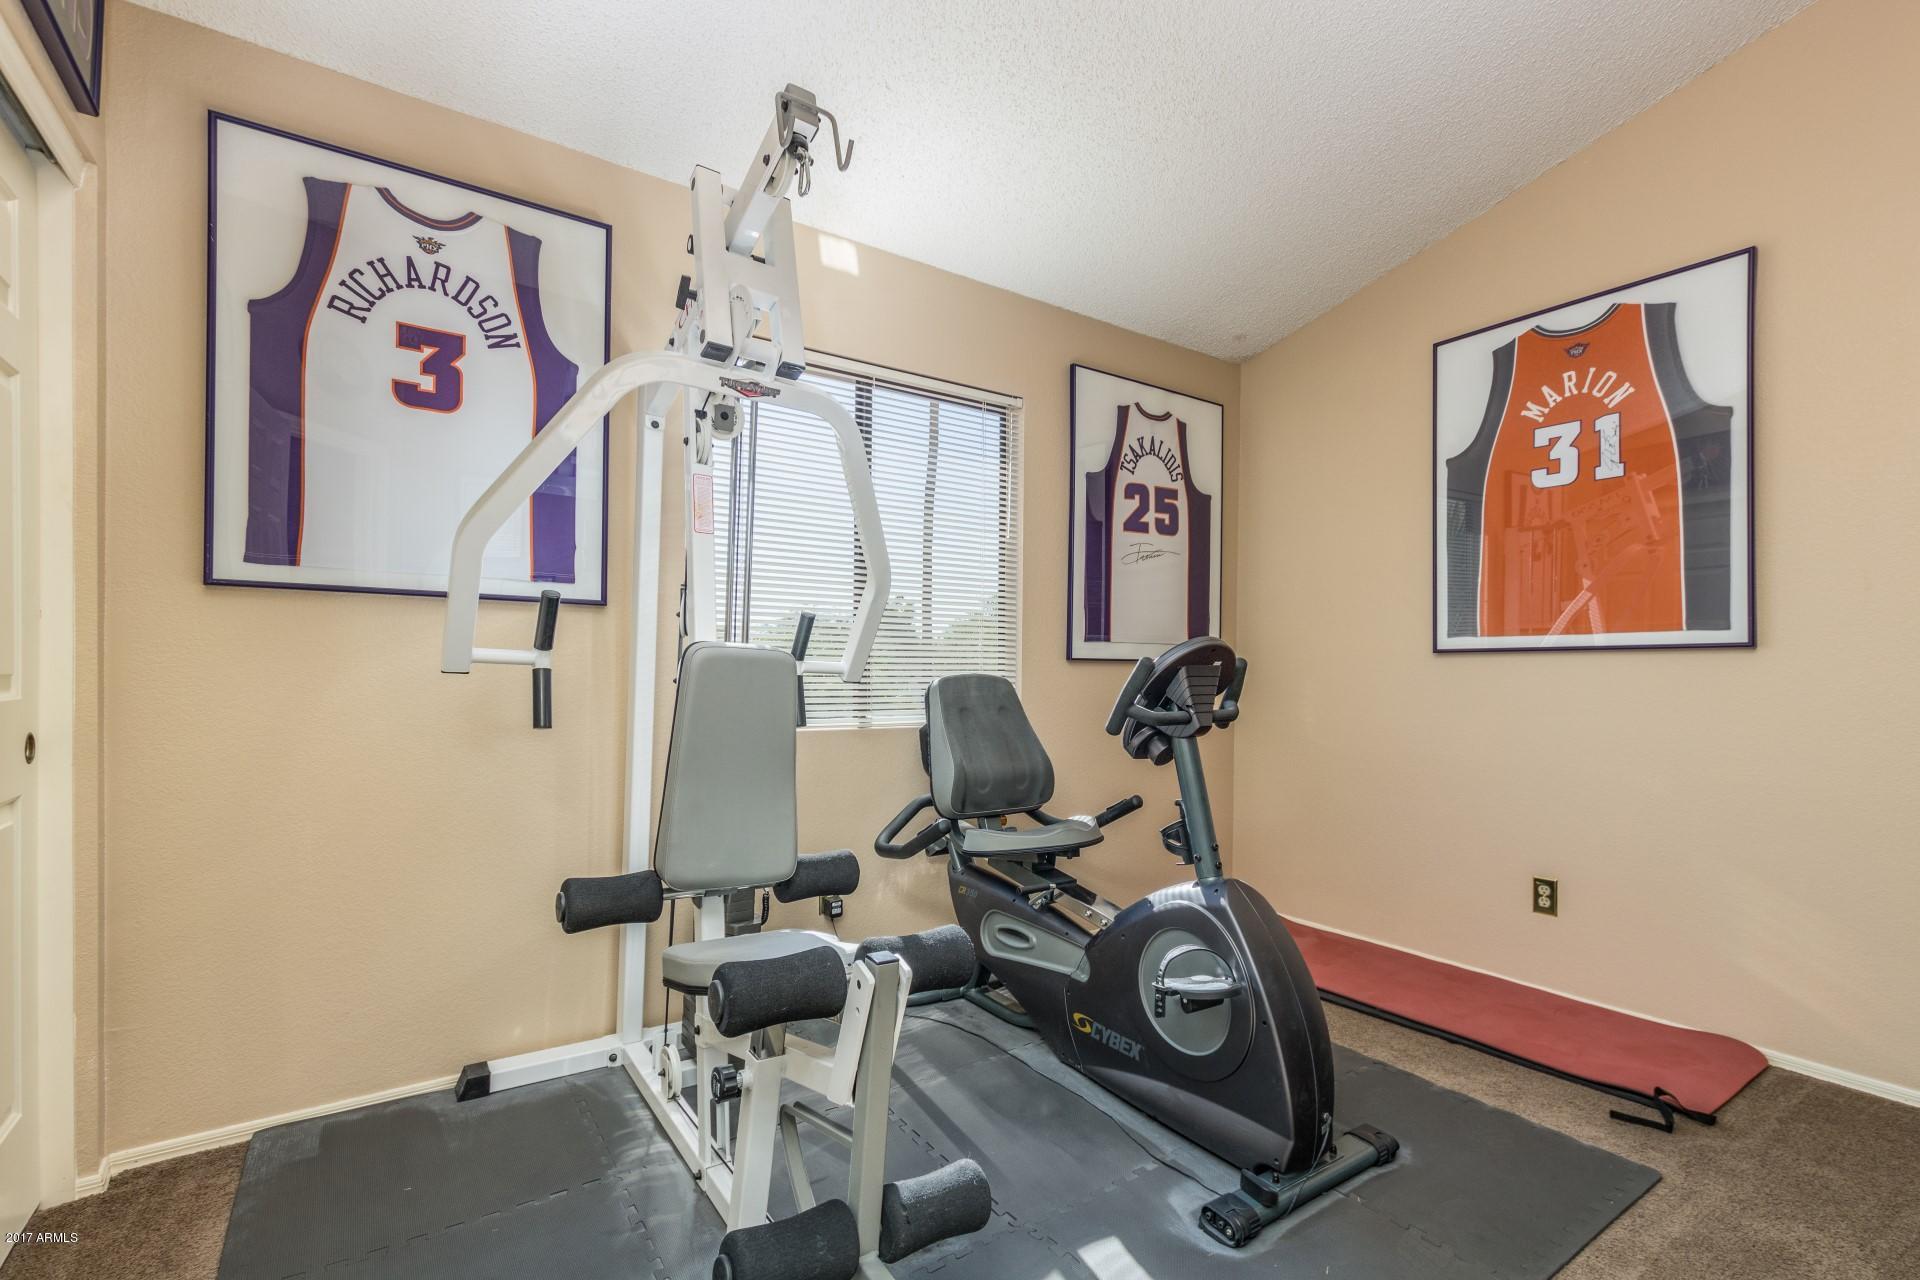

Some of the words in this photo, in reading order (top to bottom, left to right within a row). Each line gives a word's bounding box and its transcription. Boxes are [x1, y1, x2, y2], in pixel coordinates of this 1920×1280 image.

[327, 256, 521, 349] RICHARDSON
[391, 320, 467, 415] 3
[1520, 367, 1635, 423] MARION
[1120, 435, 1183, 482] TSAKALIDIS
[1530, 411, 1625, 489] 31
[1122, 481, 1180, 537] 25
[1090, 1021, 1141, 1062] CYBEX
